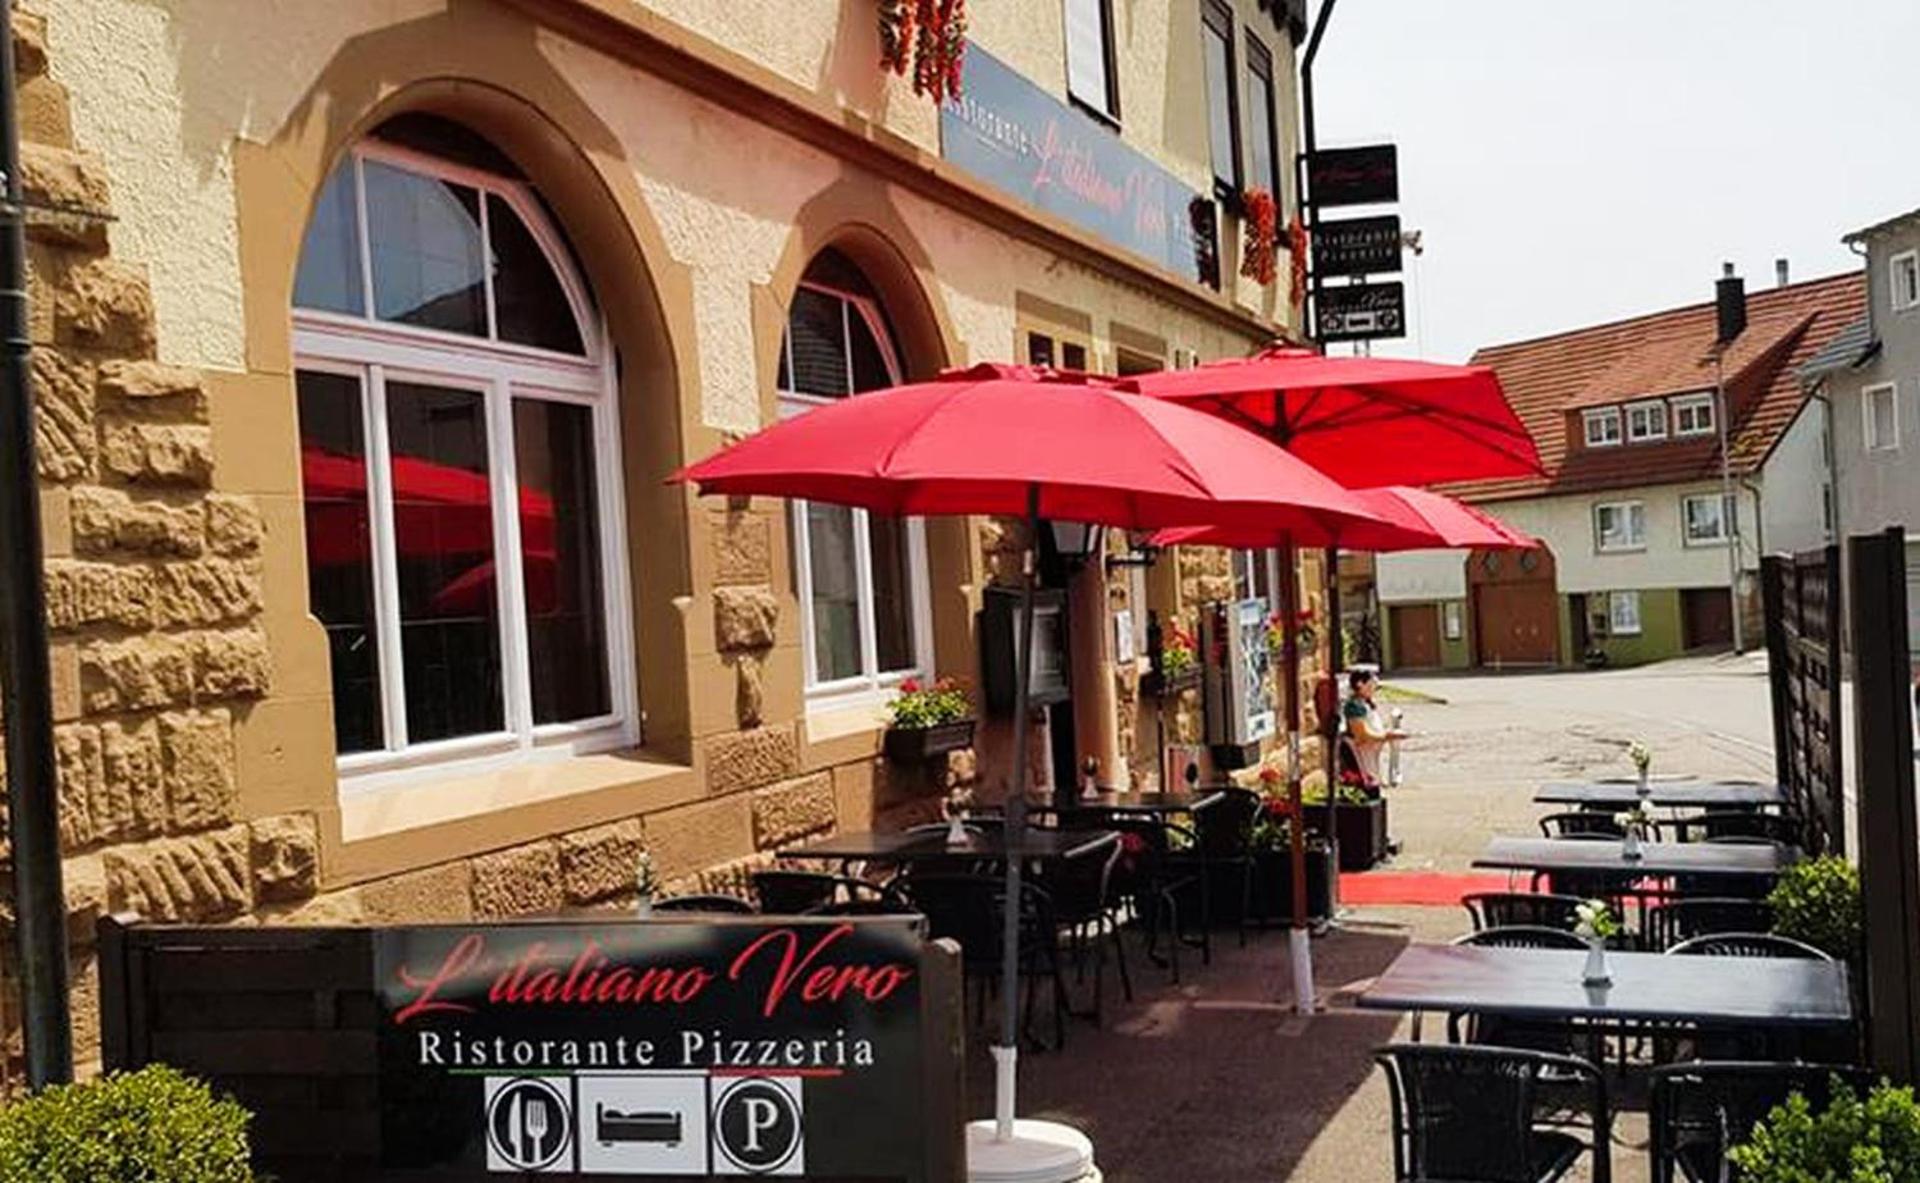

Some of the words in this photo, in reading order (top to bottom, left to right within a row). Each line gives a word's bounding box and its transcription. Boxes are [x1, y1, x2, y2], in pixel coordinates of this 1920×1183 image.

[730, 922, 912, 1017] Vero
[418, 1030, 655, 1065] Ristorante
[682, 1029, 874, 1065] Pizzeria
